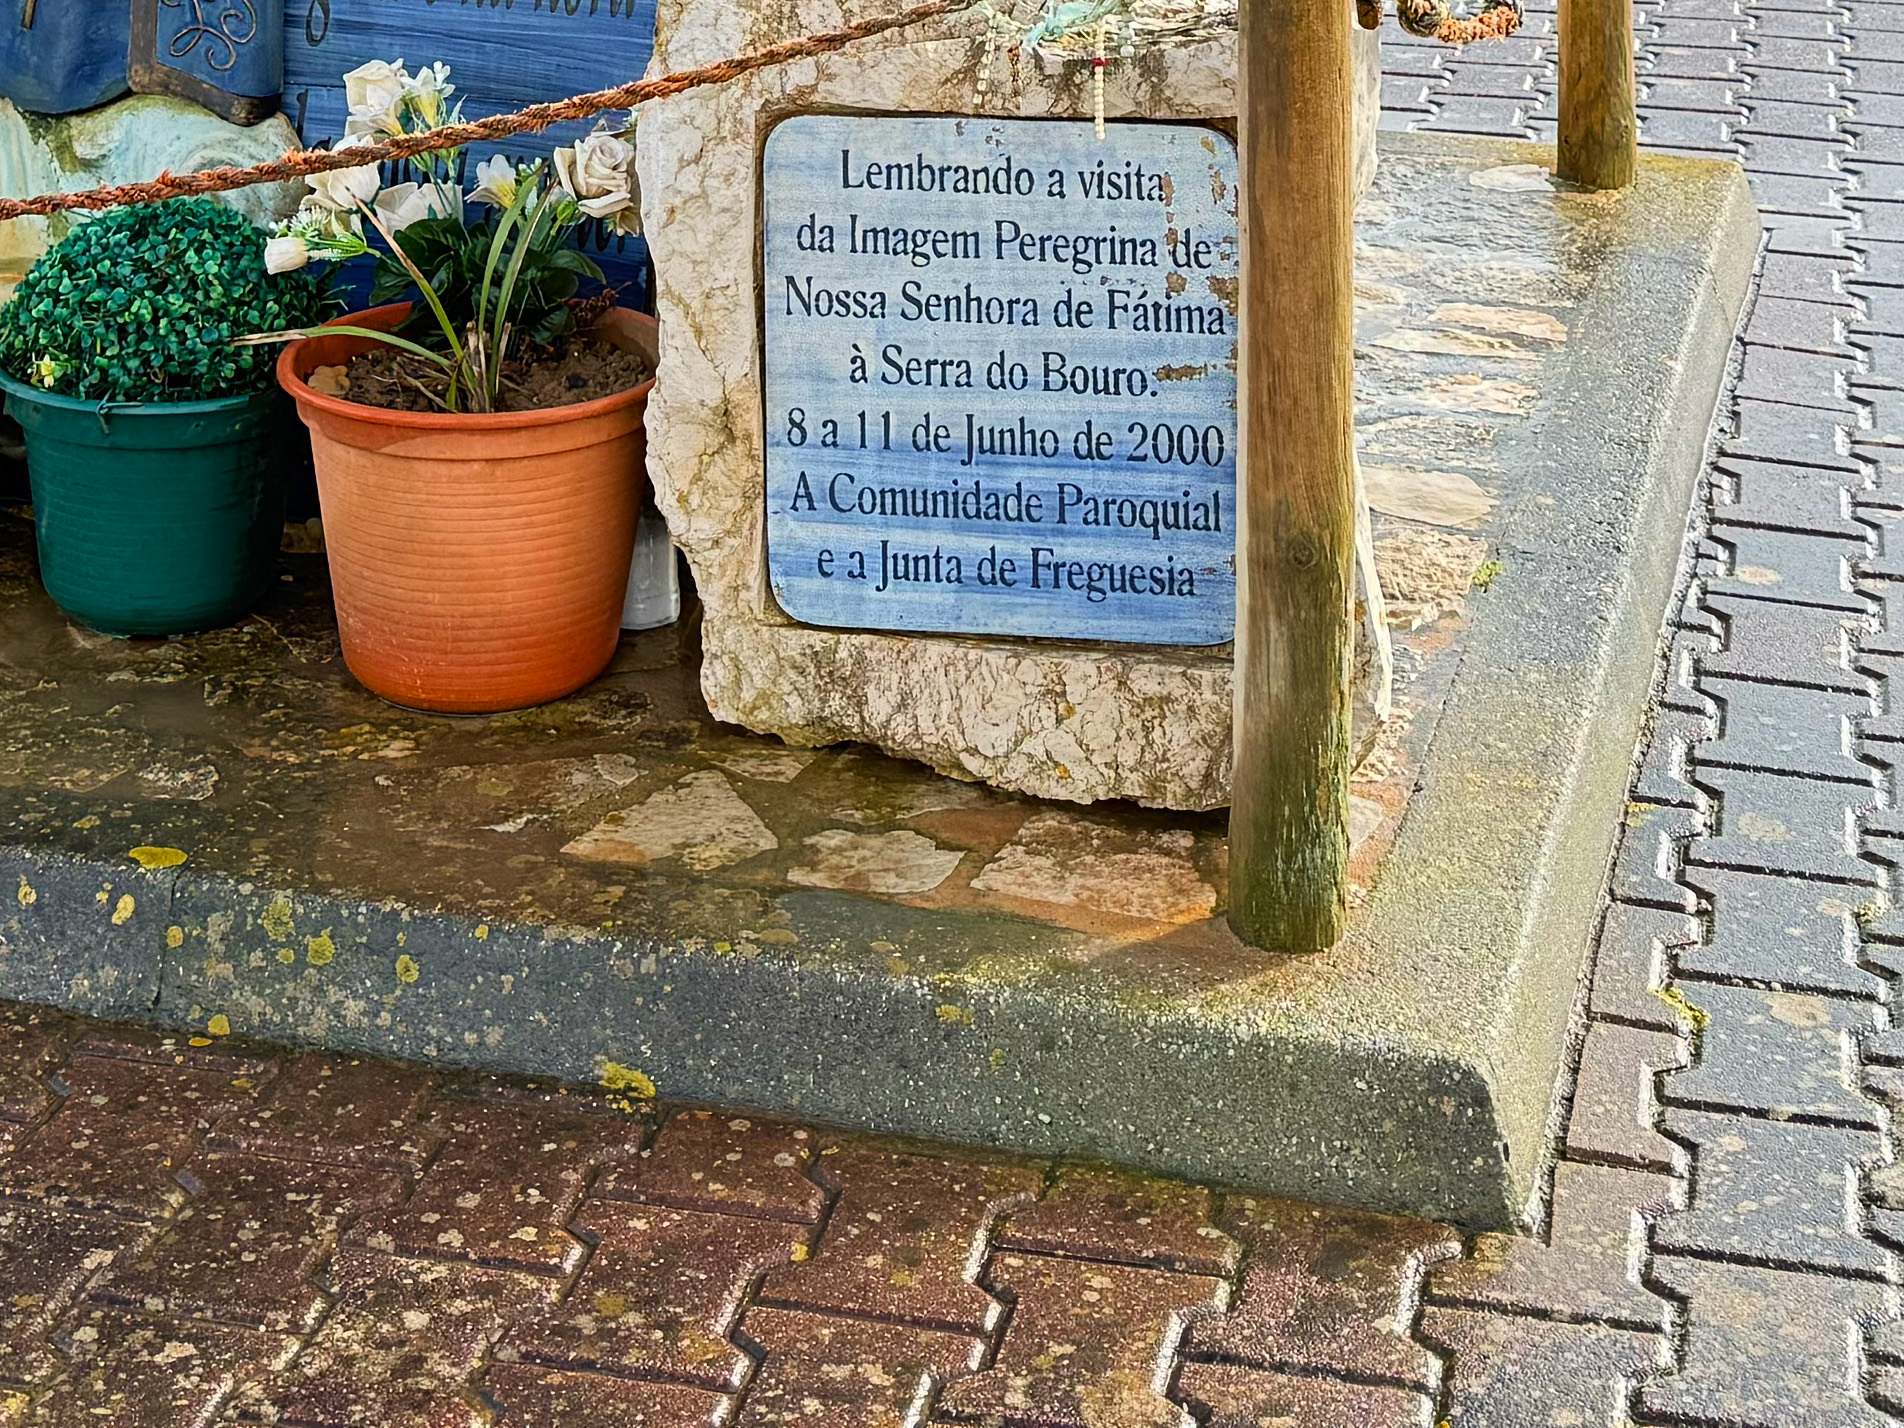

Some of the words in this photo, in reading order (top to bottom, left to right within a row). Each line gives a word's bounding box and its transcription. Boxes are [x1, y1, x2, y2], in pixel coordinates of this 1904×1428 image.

[841, 150, 1035, 198] Lembrando
[1047, 168, 1067, 200] a
[1079, 160, 1167, 203] visita
[796, 214, 835, 254] da
[850, 215, 981, 267] Imagem
[995, 220, 1159, 274] Peregrina
[1171, 229, 1213, 271] de
[785, 275, 887, 320] Nossa
[900, 281, 1039, 327] Senhora
[1053, 288, 1094, 330] de
[1108, 289, 1226, 336] Fátima
[849, 344, 869, 385] à
[881, 344, 972, 388] Serra
[986, 350, 1029, 392] do
[1042, 352, 1160, 398] Bouro.
[787, 407, 808, 448] 8
[821, 418, 839, 448] a
[857, 410, 891, 451] 11
[912, 412, 951, 453] de
[961, 413, 1060, 466] Junho
[1073, 419, 1114, 462] de
[1126, 422, 1226, 467] 2000
[789, 471, 817, 513] A
[829, 472, 1044, 524] Comunidade
[1057, 482, 1222, 541] Paroquial
[817, 548, 834, 579] e
[847, 550, 867, 580] a
[875, 540, 963, 592] Junta
[977, 545, 1018, 586] de
[1030, 547, 1196, 603] Freguesia
